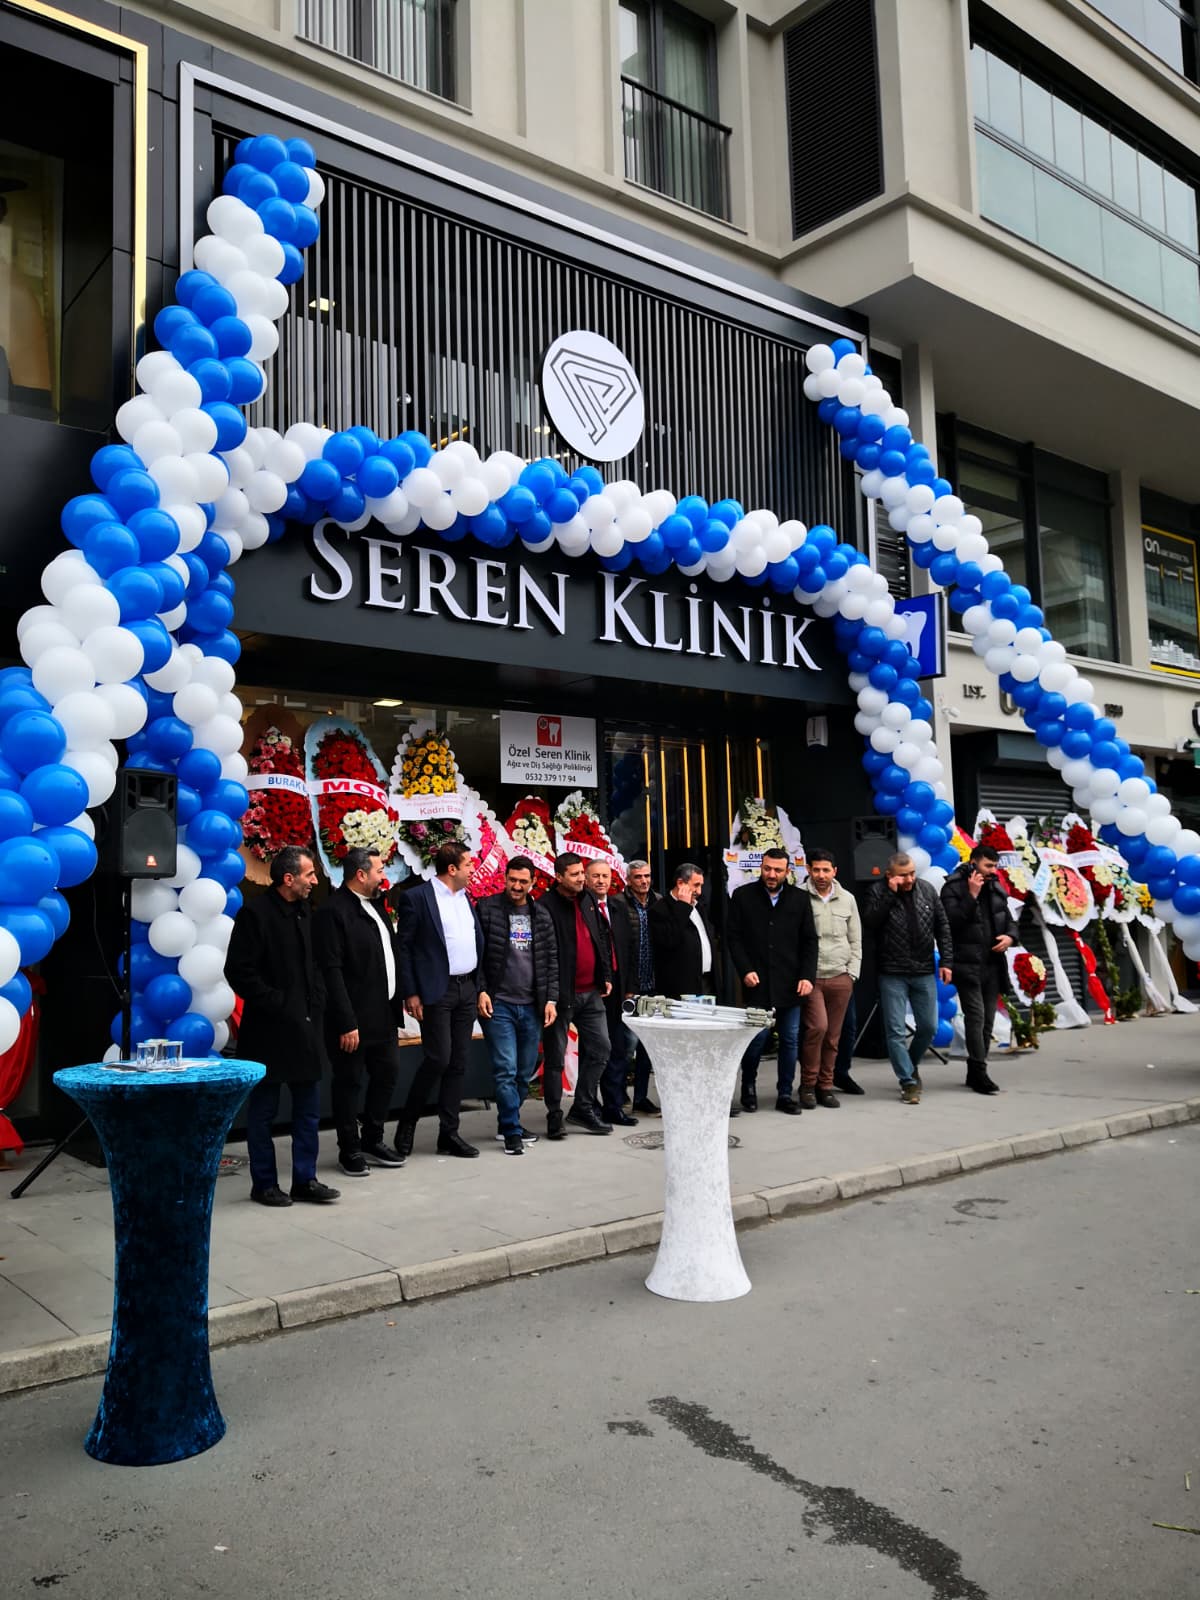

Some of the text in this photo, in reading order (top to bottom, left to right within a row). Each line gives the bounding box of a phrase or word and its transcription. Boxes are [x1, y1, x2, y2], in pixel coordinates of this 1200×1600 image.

[311, 518, 822, 671] SEREN KLİNİK
[508, 744, 592, 761] Özel Seren Klinik
[507, 760, 521, 769] Ağız
[531, 762, 541, 770] Diş
[542, 762, 563, 772] Sağlığı
[268, 776, 301, 789] BURAK
[525, 773, 543, 781] 0532
[544, 774, 557, 782] 379
